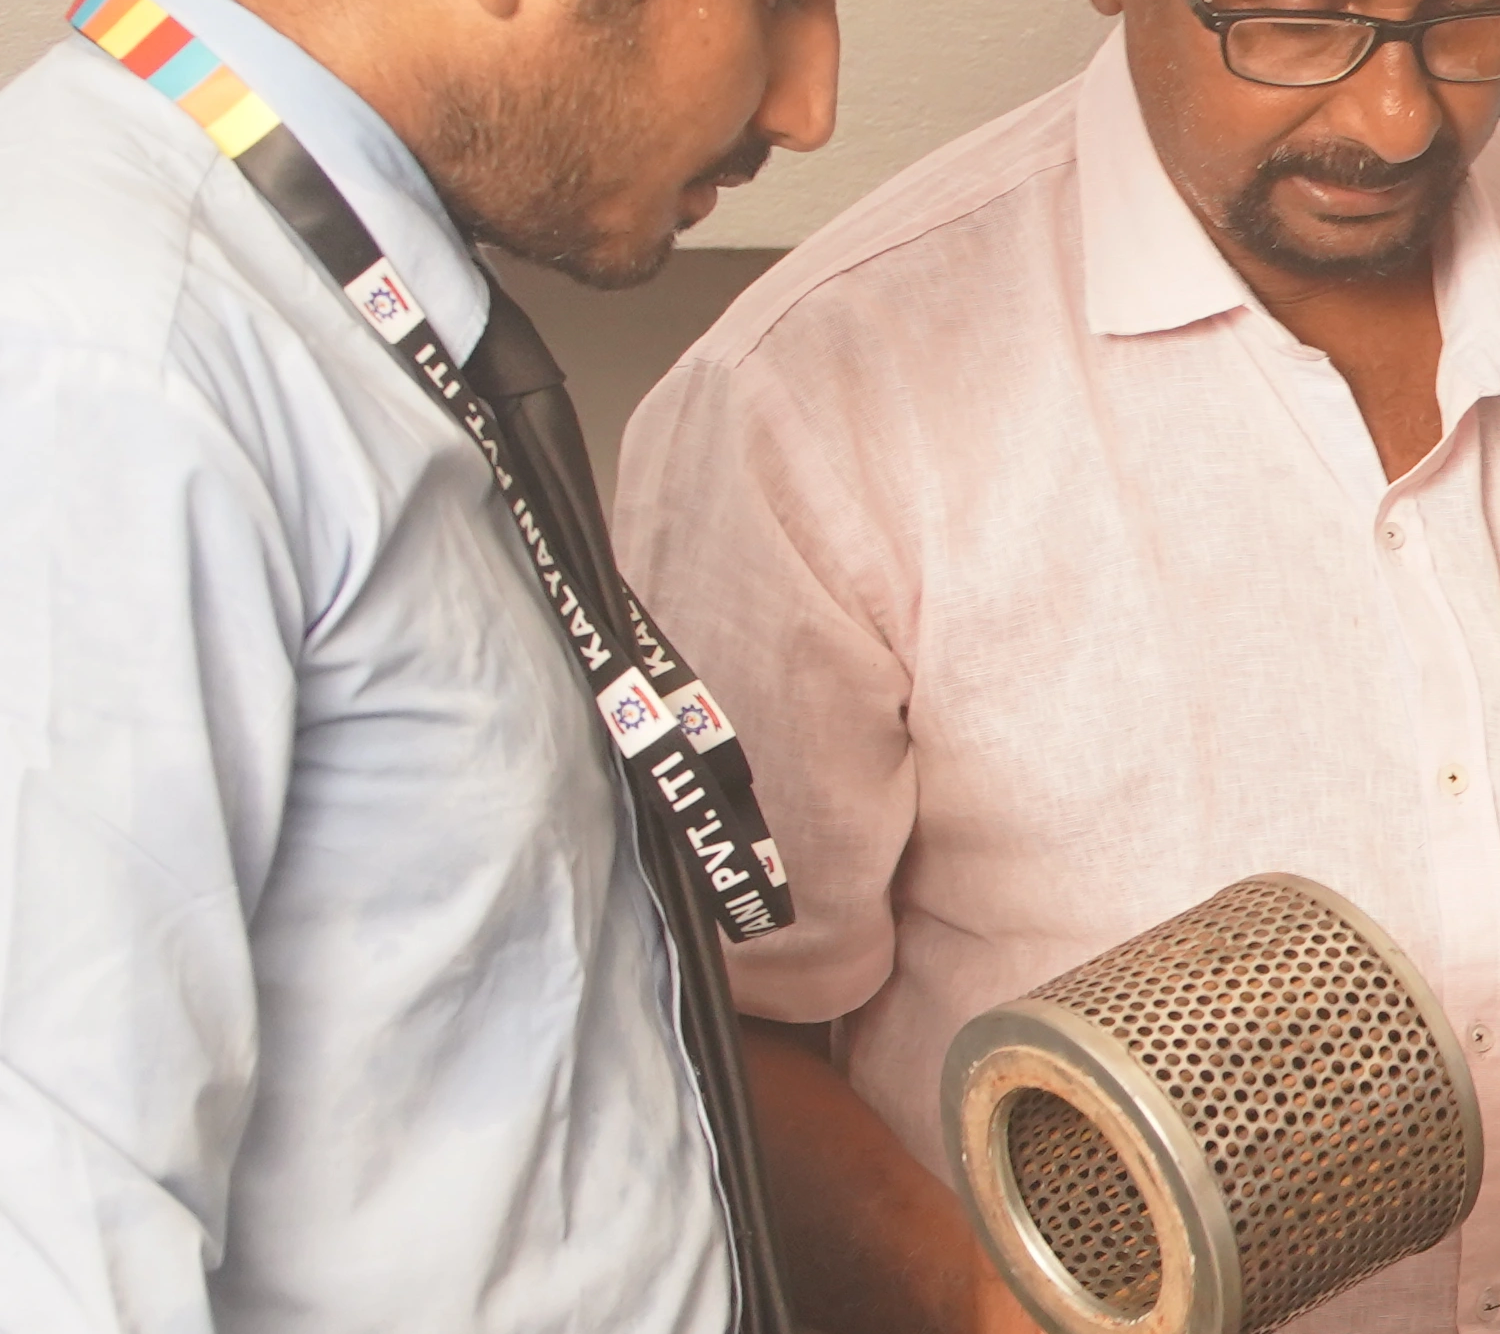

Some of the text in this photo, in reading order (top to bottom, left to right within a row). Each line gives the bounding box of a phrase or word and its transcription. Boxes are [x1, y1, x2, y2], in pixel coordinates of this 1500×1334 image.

[414, 343, 461, 399] ITI
[513, 498, 612, 672] KALYANI
[651, 750, 706, 813] ITI
[686, 808, 750, 893] PVT.
